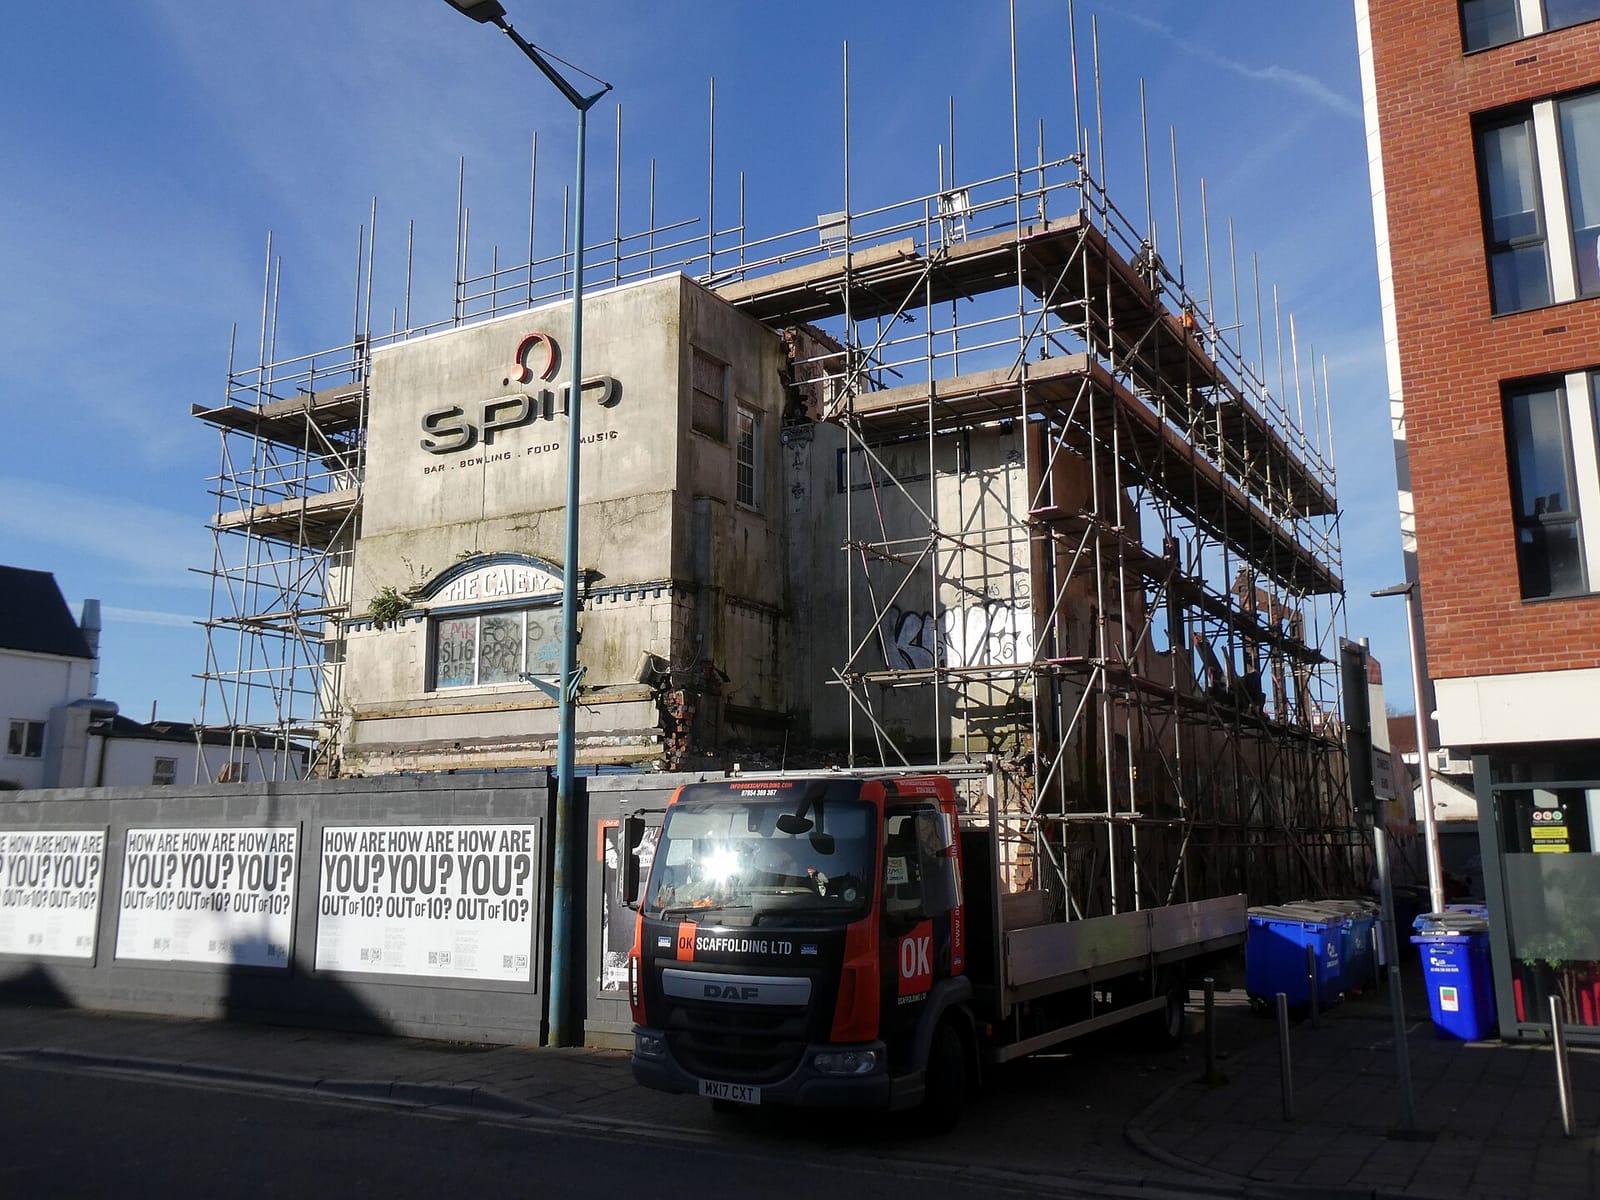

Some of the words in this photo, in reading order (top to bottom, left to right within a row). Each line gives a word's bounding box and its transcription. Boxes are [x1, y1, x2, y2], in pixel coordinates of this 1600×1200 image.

[424, 463, 446, 475] BAR
[459, 451, 512, 469] BOWLING
[527, 442, 561, 457] FOOD
[577, 430, 619, 445] MUSIC
[445, 574, 480, 601] THE
[128, 833, 156, 851] HOW
[157, 833, 180, 852] ARE
[182, 832, 211, 852] HOW
[212, 833, 236, 852] ARE
[238, 833, 267, 853] HOW
[270, 833, 294, 853] ARE
[324, 832, 358, 852] HOW
[359, 832, 386, 852] ARE
[388, 831, 424, 852] HOW
[425, 831, 454, 853] ARE
[457, 830, 497, 852] HOW
[499, 830, 531, 852] ARE
[8, 855, 51, 887] YOU?
[54, 855, 100, 888] YOU?
[127, 853, 177, 889] YOU?
[181, 853, 234, 890] YOU?
[237, 854, 293, 892] YOU?
[324, 854, 385, 894] YOU?
[387, 854, 454, 895] YOU?
[457, 854, 531, 896] YOU?
[123, 890, 146, 910] OUT
[155, 891, 175, 911] 10?
[177, 891, 200, 911] OUT
[211, 892, 231, 912] 10?
[233, 893, 259, 913] OUT
[259, 901, 268, 913] OF
[269, 894, 290, 915] 10?
[321, 895, 349, 916] OUT
[349, 901, 360, 915] OF
[360, 896, 383, 918] 10?
[386, 896, 415, 918] OUT
[415, 903, 427, 917] OF
[427, 898, 452, 920] 10?
[456, 898, 488, 921] OUT
[488, 905, 501, 919] OF
[501, 898, 529, 922] 10?
[678, 936, 693, 950] OK
[696, 937, 768, 954] SCAFFOLDING
[771, 940, 792, 955] LTD
[901, 936, 930, 978] OK
[704, 984, 759, 1000] DAF
[705, 1081, 729, 1097] MX17
[732, 1086, 753, 1101] CXT
